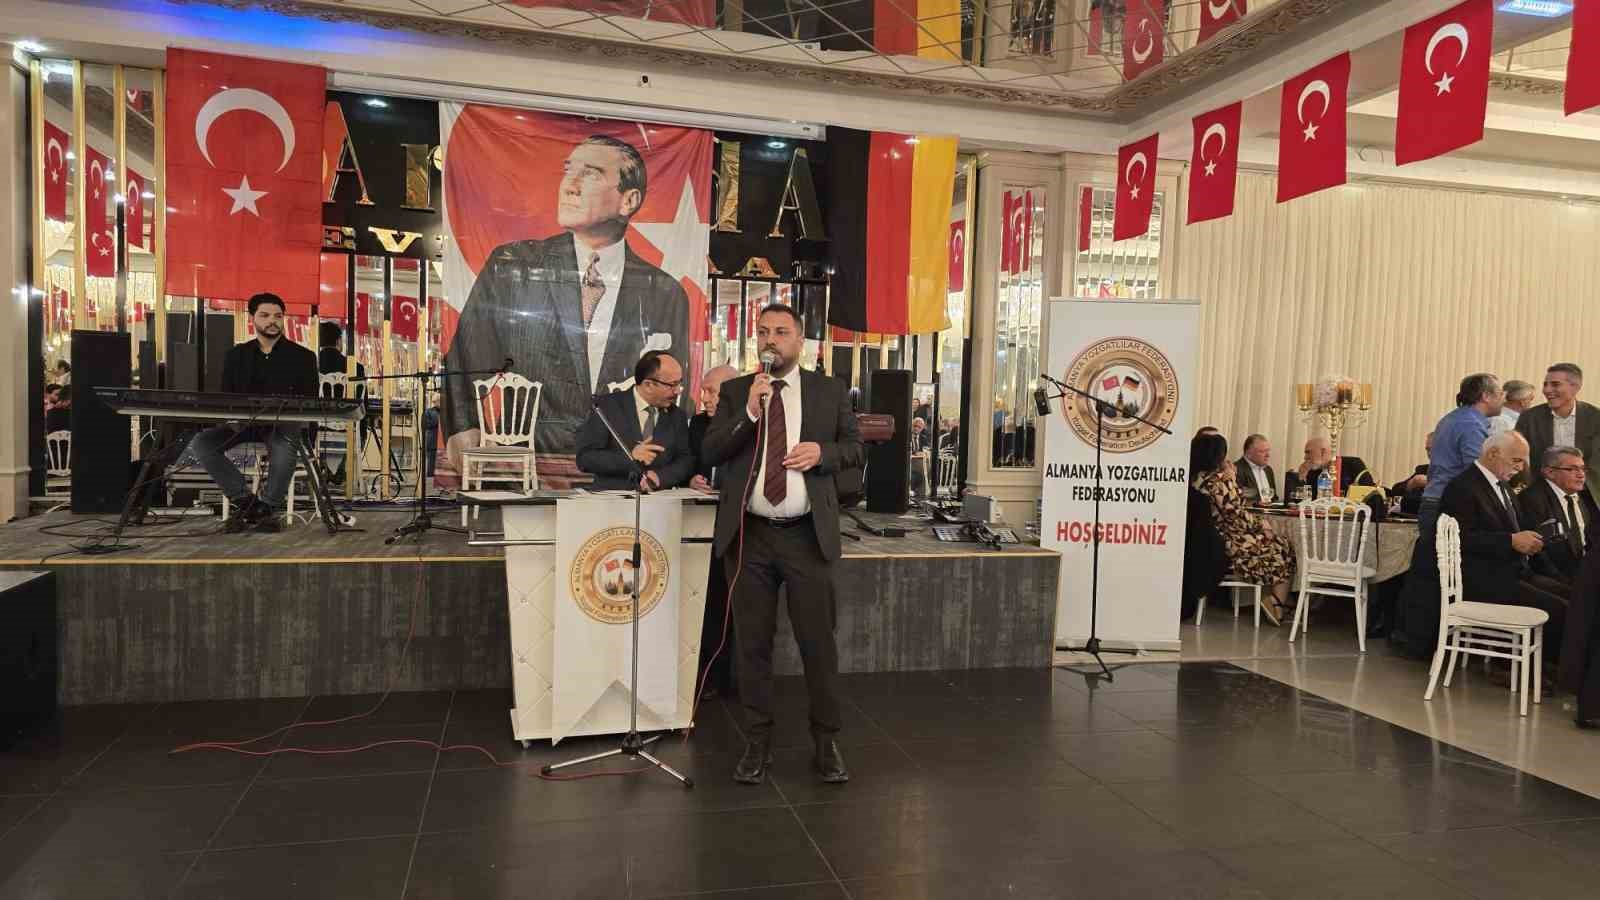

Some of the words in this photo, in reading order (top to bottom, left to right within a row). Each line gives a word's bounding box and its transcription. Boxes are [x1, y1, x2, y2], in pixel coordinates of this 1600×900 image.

[1083, 340, 1141, 362] YOZGATLILAR
[1140, 345, 1175, 405] FEDERASYONU
[1046, 464, 1103, 480] ALMANYA
[1107, 465, 1185, 483] YOZGATLILAR
[1072, 486, 1156, 504] FEDERASYONU
[1056, 517, 1168, 549] HOŞGELDİNİZ
